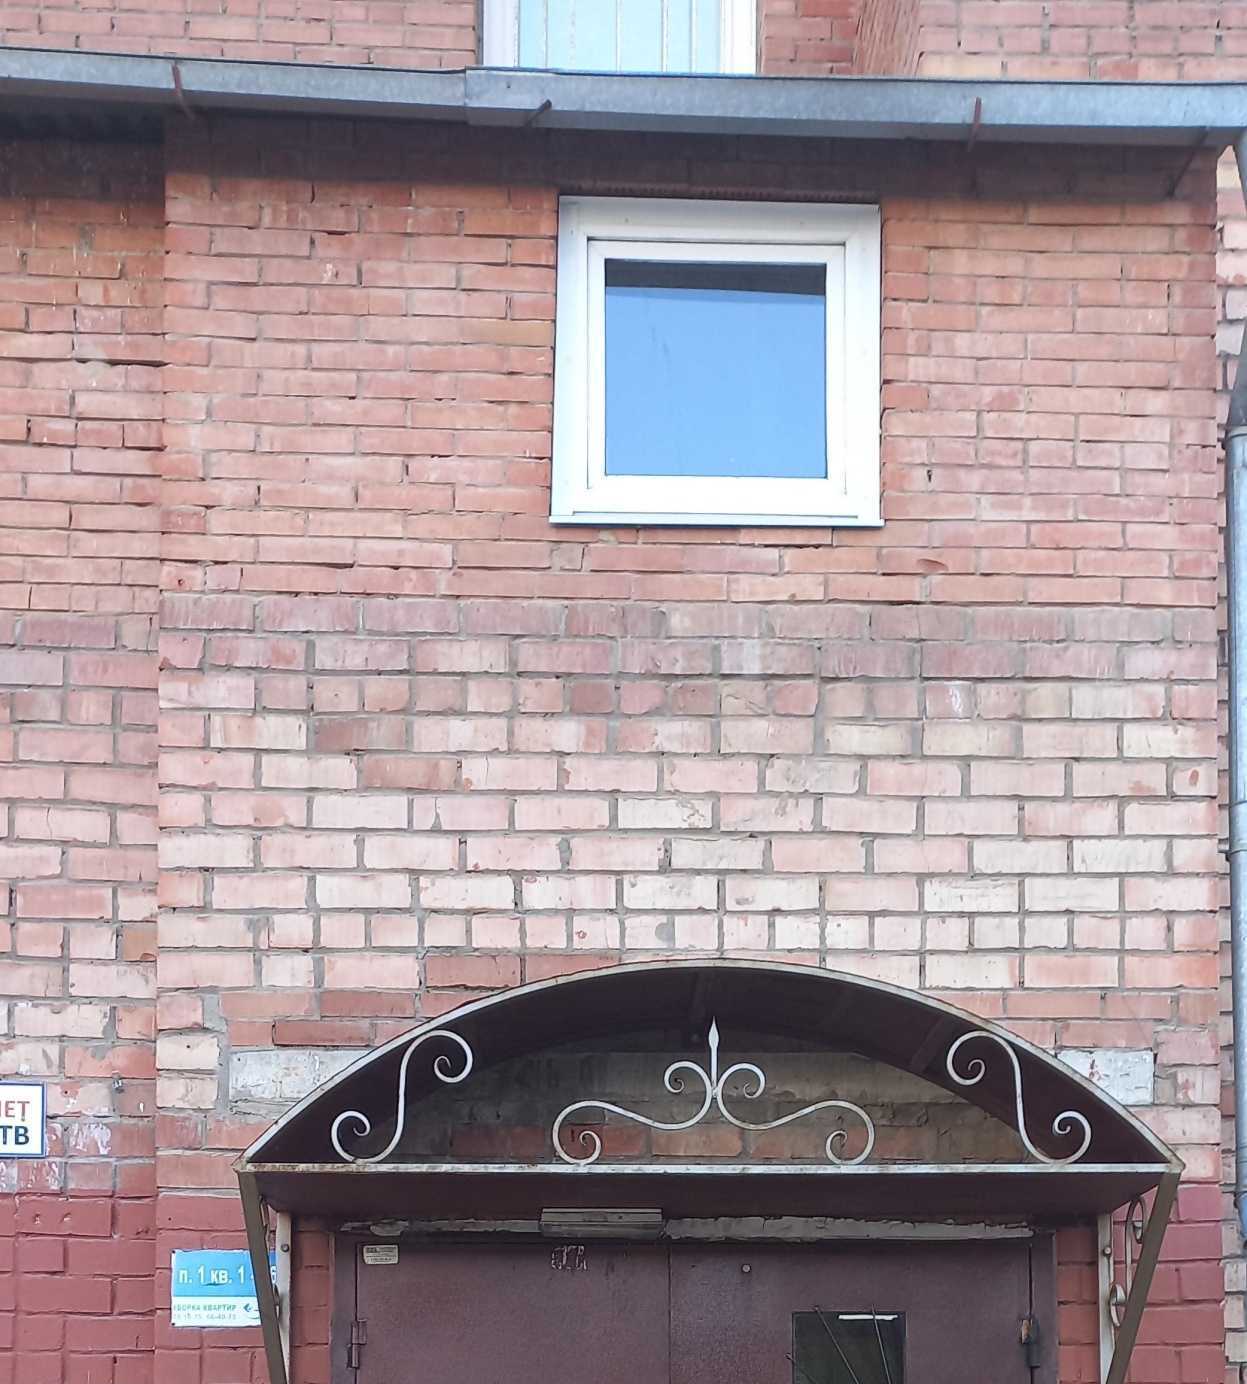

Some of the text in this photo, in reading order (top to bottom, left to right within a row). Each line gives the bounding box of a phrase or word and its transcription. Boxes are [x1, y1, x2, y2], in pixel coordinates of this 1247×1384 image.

[179, 1269, 193, 1284] п.
[198, 1265, 205, 1284] 1
[211, 1269, 233, 1285] кв.
[238, 1265, 245, 1284] 1
